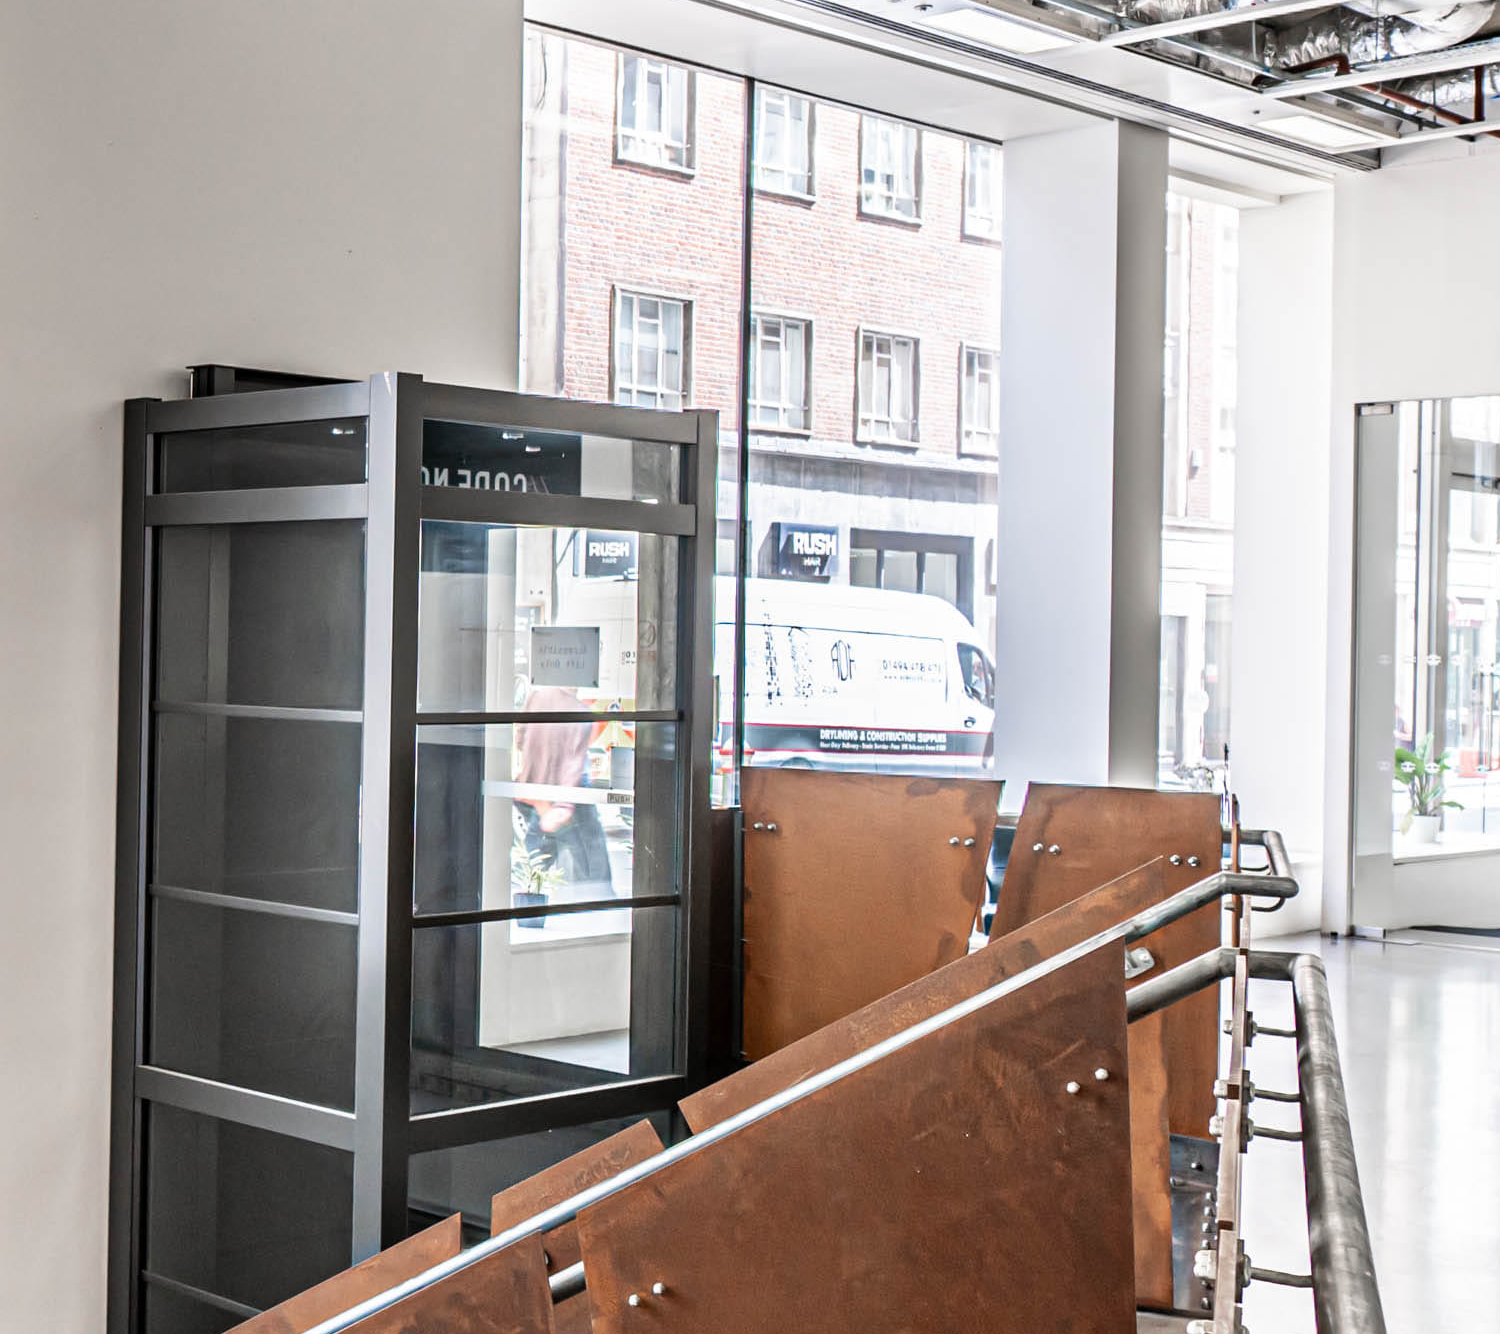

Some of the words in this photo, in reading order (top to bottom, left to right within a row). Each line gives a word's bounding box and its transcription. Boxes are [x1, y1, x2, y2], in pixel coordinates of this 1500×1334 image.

[588, 542, 630, 557] RUSH
[793, 532, 837, 555] RUSH
[820, 729, 858, 741] DRYLINING
[866, 731, 916, 742] CONSTRUCTION
[609, 794, 631, 803] PUSH
